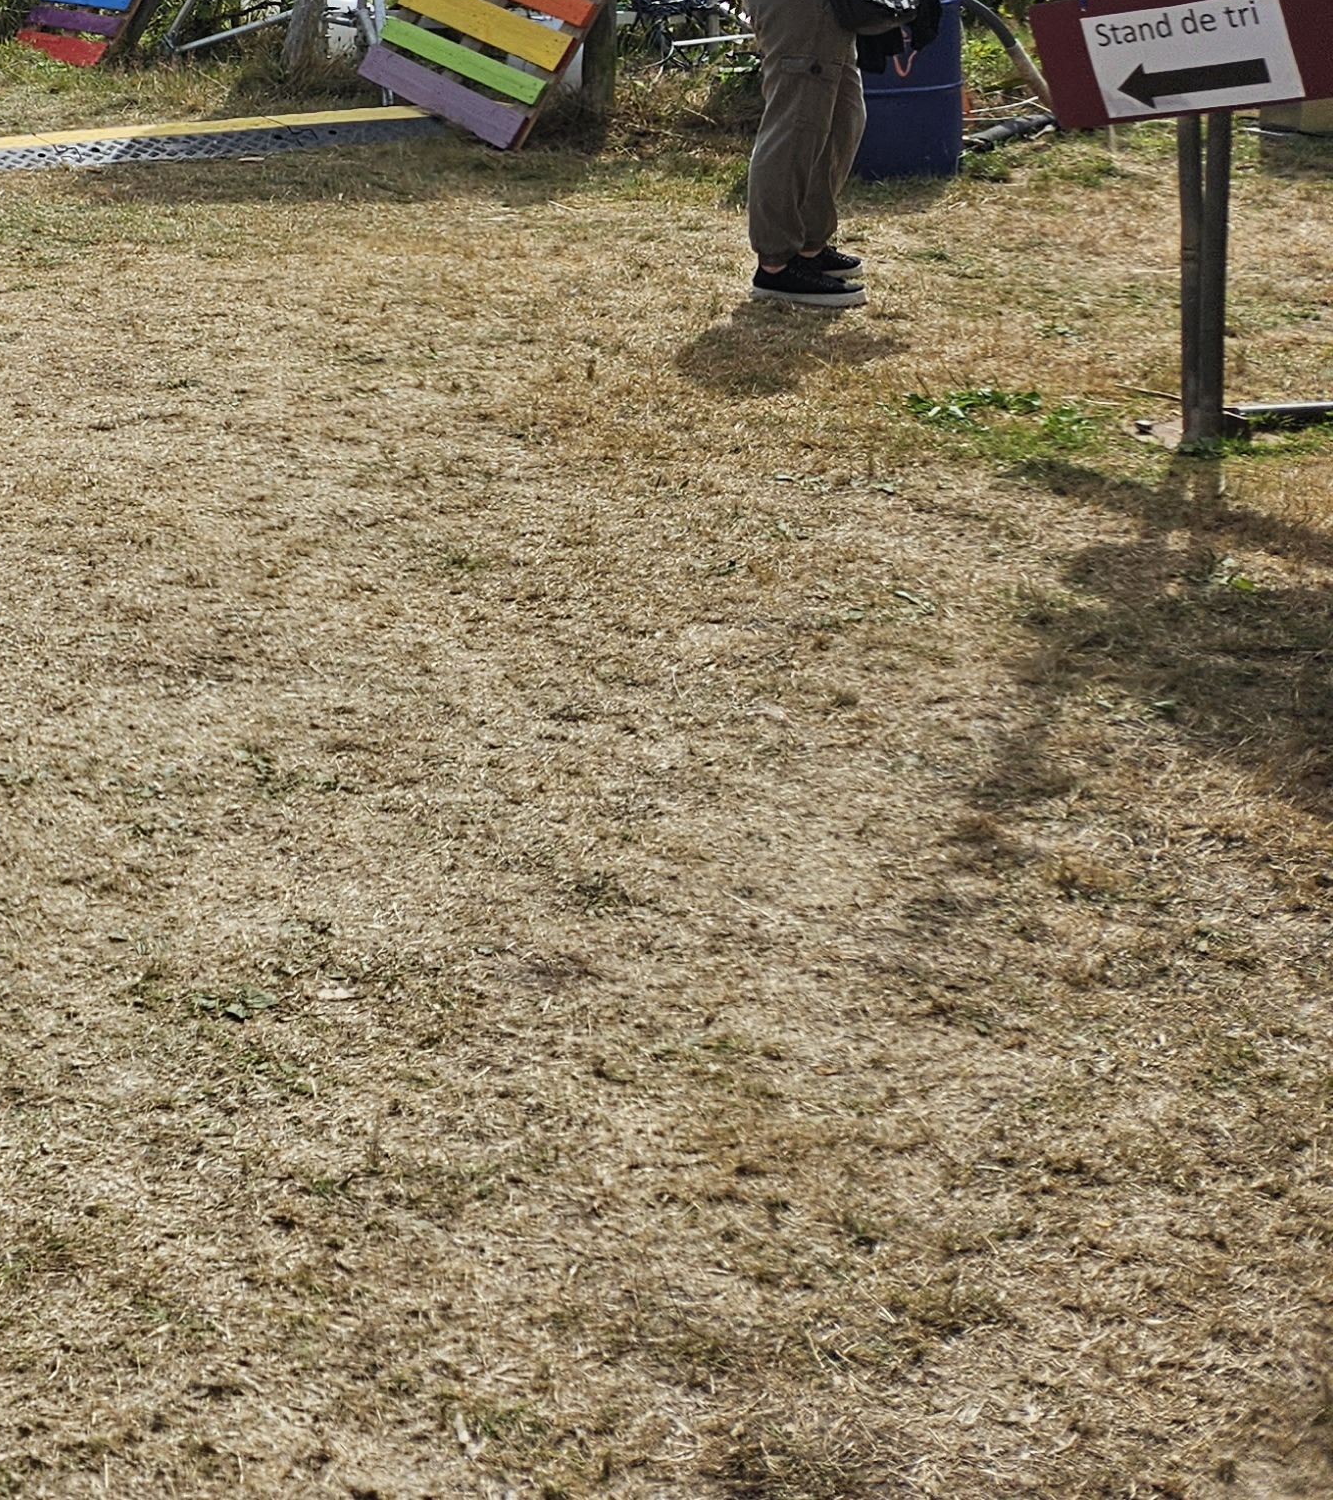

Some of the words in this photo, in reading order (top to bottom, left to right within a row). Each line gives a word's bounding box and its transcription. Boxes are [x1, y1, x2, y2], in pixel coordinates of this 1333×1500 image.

[1094, 12, 1173, 47] Stand
[1181, 8, 1218, 36] de
[1223, 0, 1260, 28] tri
